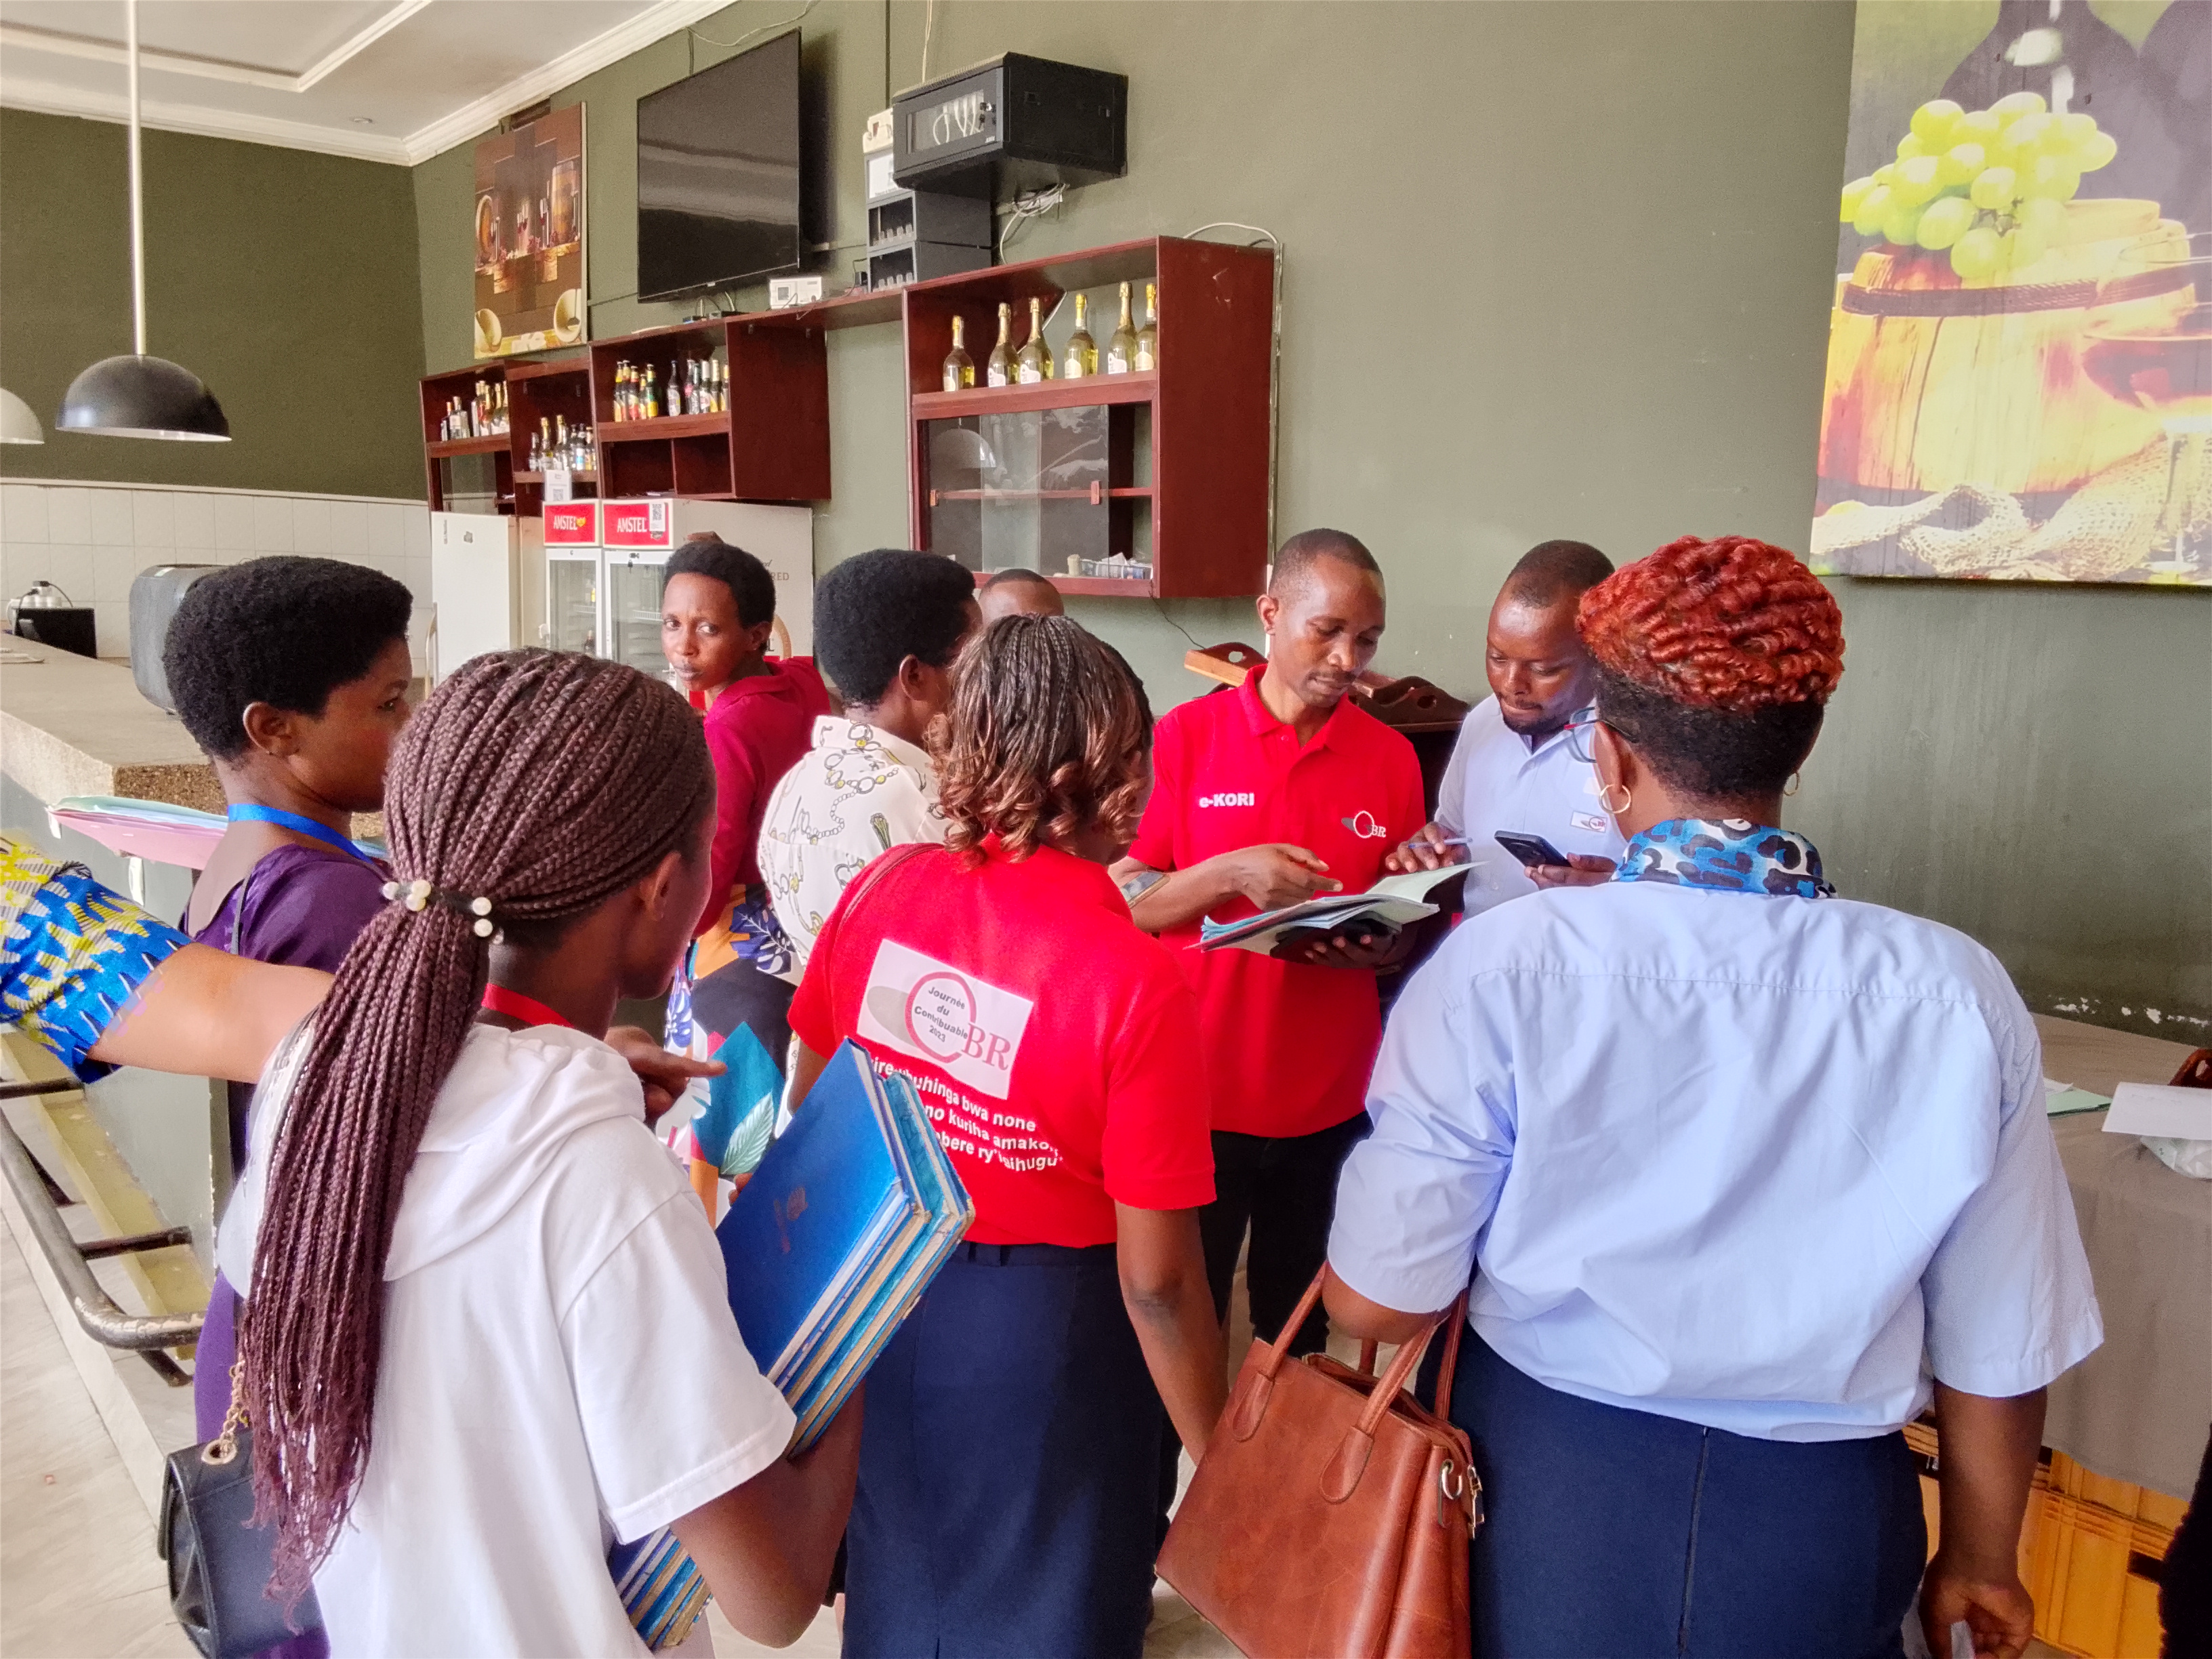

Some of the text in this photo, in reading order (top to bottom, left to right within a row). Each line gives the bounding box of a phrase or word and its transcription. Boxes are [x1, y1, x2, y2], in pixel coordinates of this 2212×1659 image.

[553, 515, 577, 531] AMSTEL
[617, 517, 647, 533] AMSTEL
[771, 572, 790, 581] RED
[1199, 792, 1254, 808] e-KORI
[928, 987, 965, 1010] Journée
[937, 1004, 950, 1016] du
[914, 1006, 968, 1040] Contribuable
[929, 1025, 946, 1043] 2023
[962, 1095, 989, 1121] bwa
[993, 1113, 1036, 1132] none
[949, 1109, 990, 1141] kuriha
[936, 1131, 975, 1155] bere
